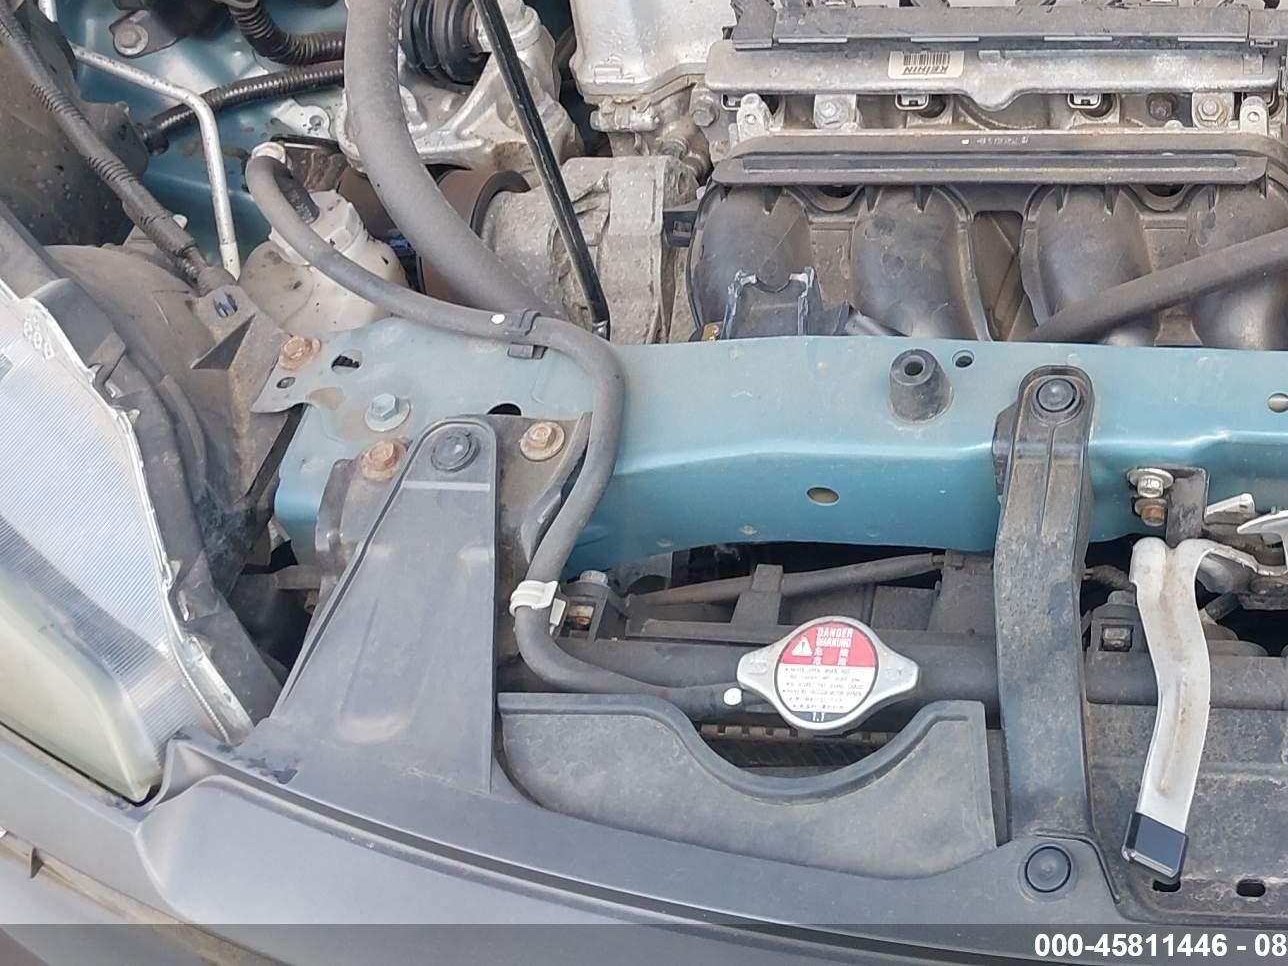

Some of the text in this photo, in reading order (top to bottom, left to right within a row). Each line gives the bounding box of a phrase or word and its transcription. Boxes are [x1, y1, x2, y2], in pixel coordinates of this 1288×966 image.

[902, 66, 948, 75] KEIHIN
[816, 627, 854, 638] DANGER
[815, 637, 851, 648] WARNING
